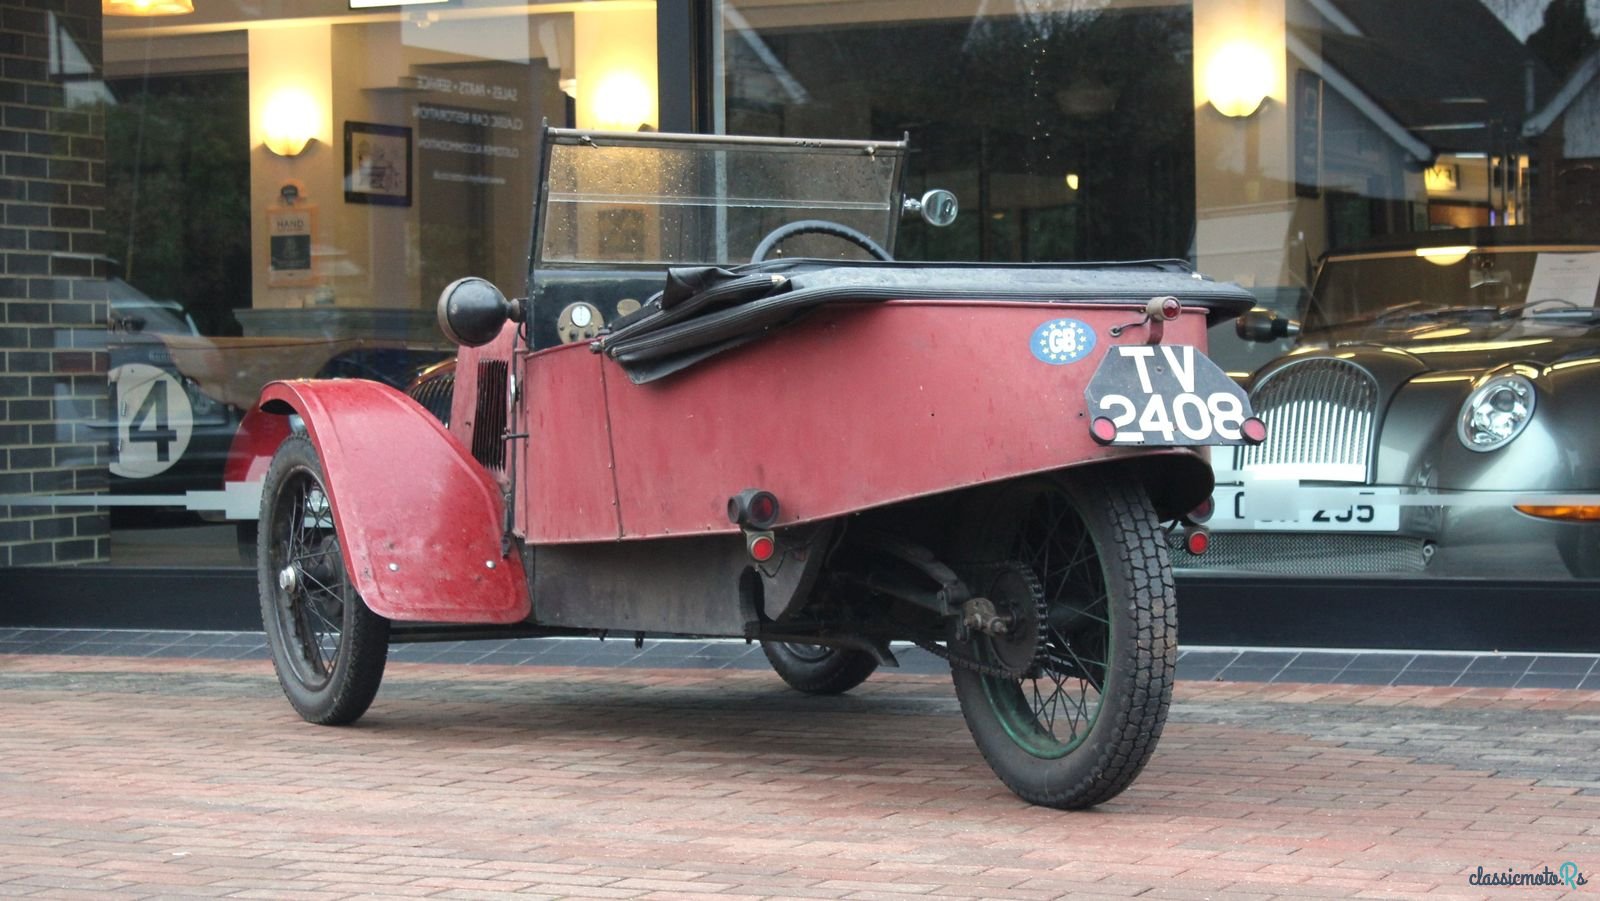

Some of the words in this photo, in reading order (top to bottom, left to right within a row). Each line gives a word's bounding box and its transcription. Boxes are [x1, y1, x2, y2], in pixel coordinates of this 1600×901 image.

[276, 219, 304, 229] HAND
[1049, 328, 1076, 353] GB
[1118, 345, 1195, 394] TV
[1099, 391, 1247, 441] 2408
